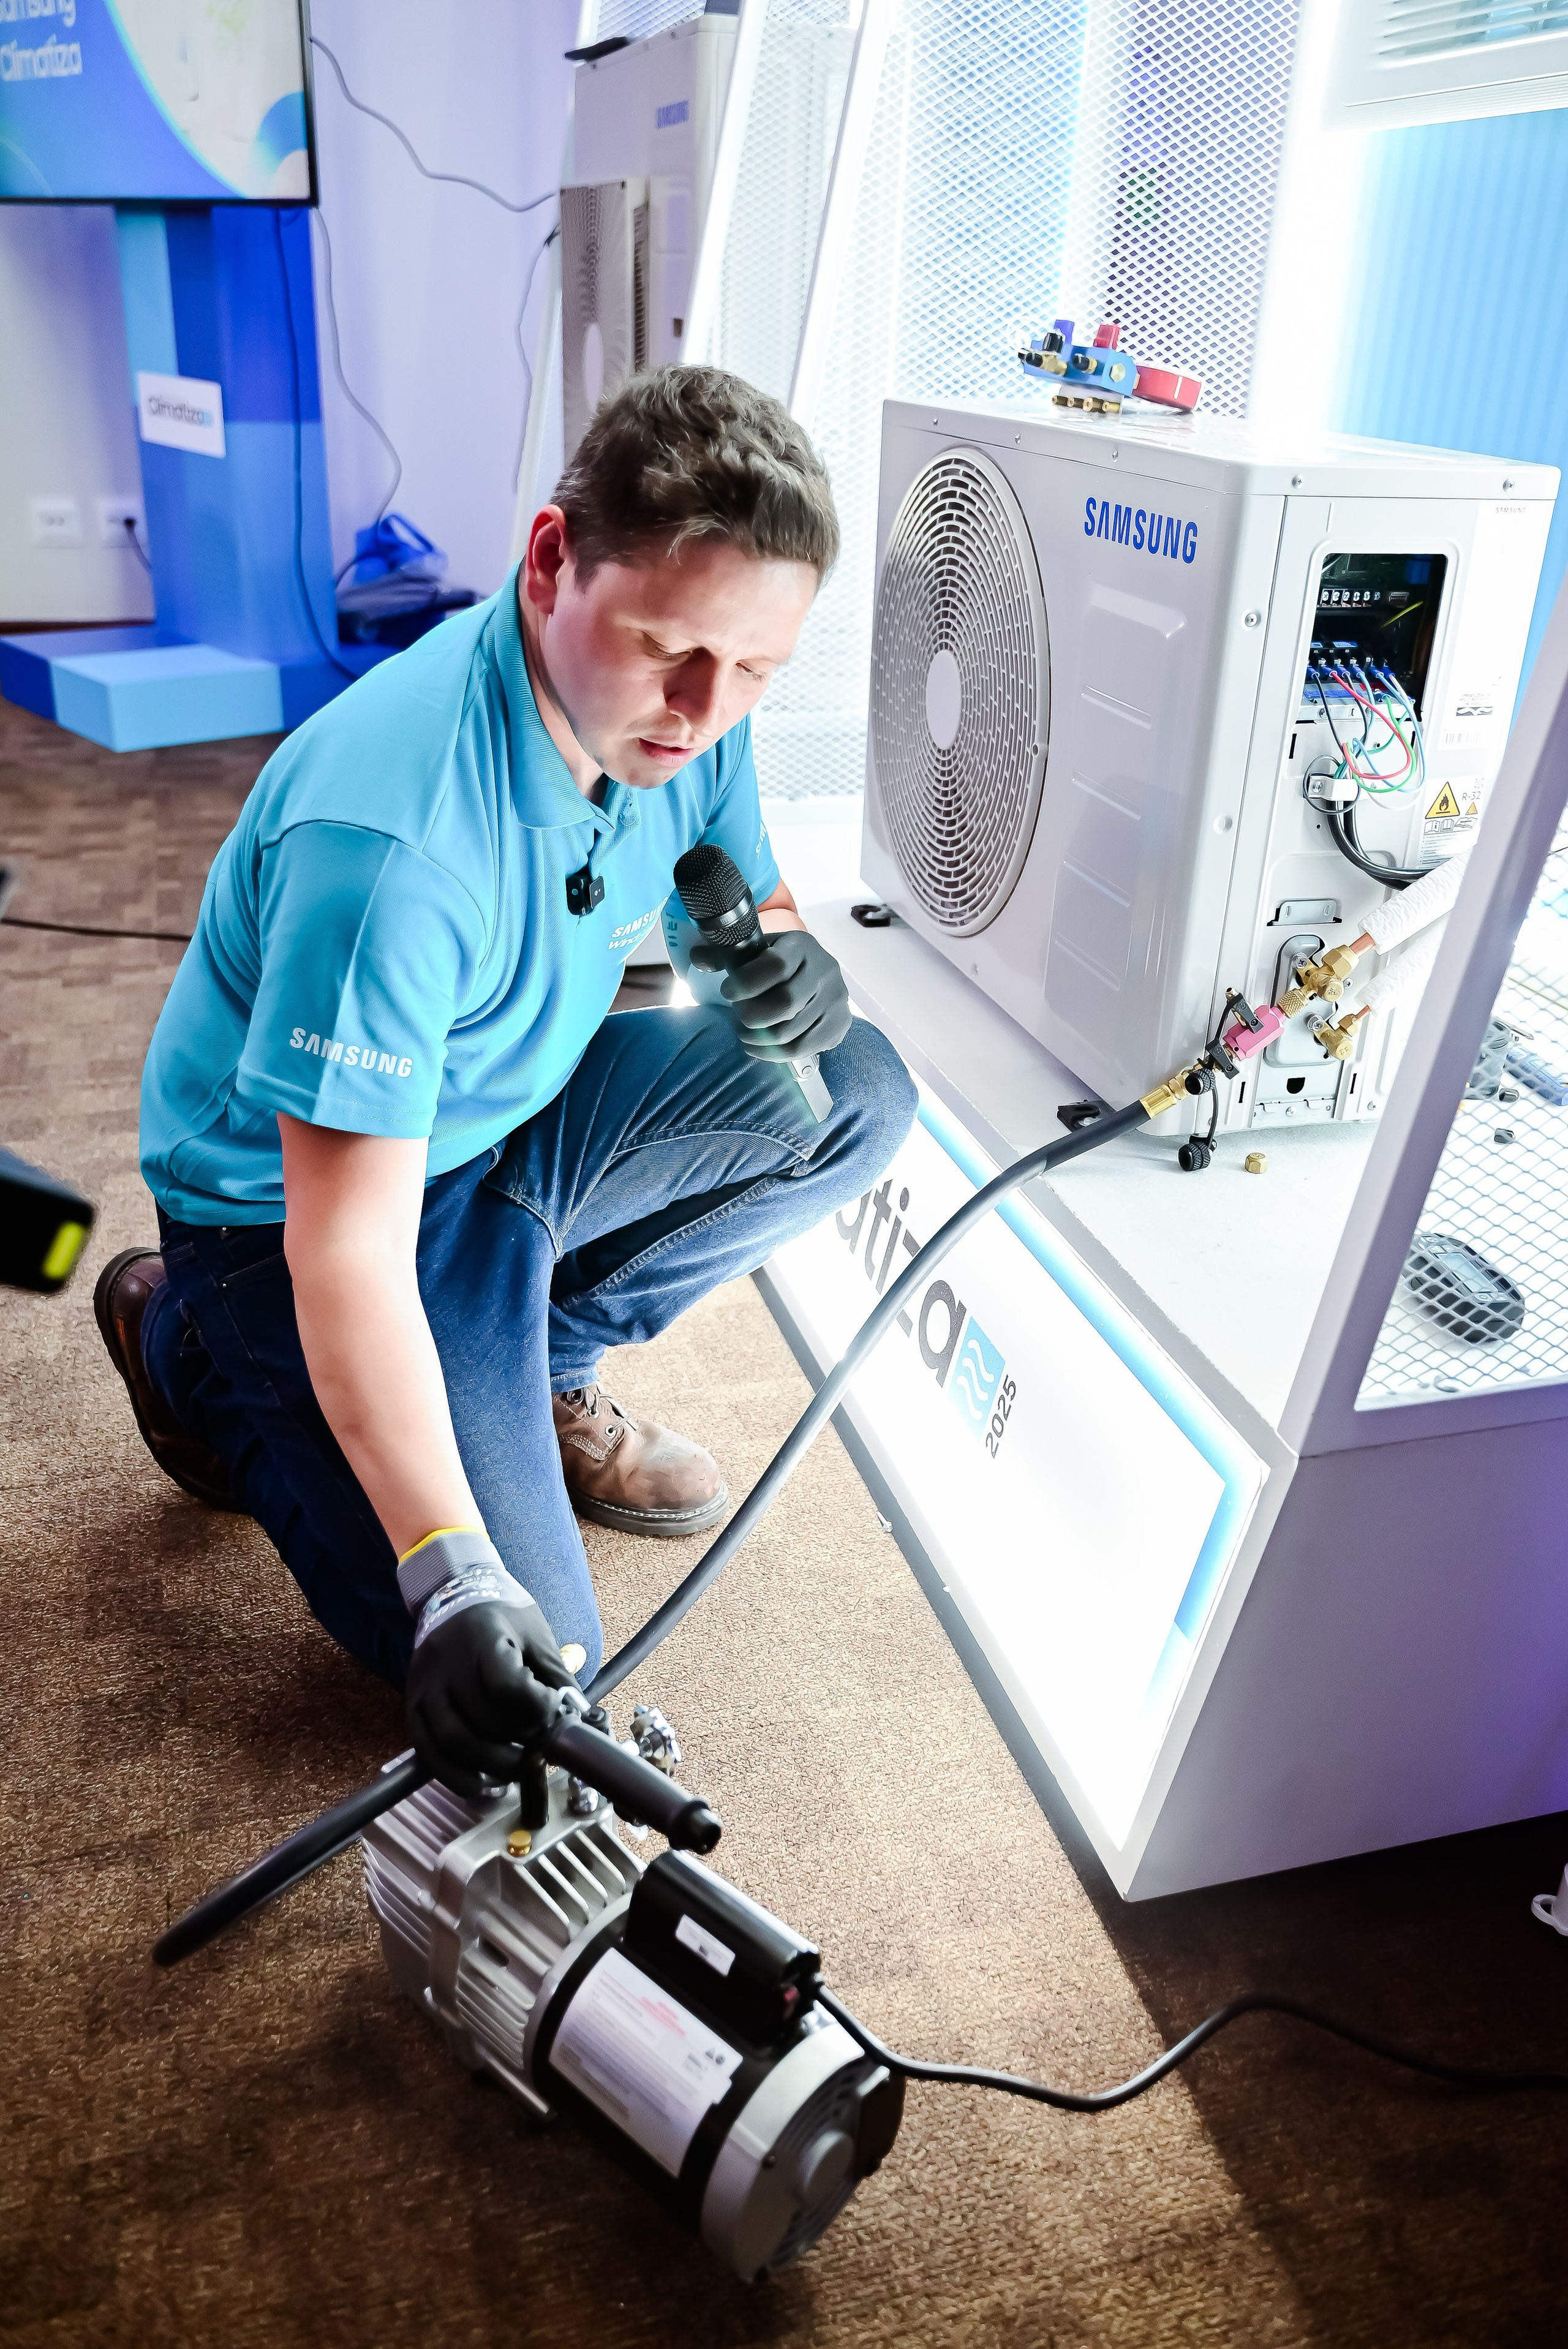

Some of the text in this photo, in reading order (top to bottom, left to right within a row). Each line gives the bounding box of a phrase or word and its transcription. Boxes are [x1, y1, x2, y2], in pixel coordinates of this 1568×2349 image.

[1084, 497, 1198, 564] SAMSUNG
[1462, 791, 1481, 801] R-32
[290, 1027, 413, 1078] SAMSUNG
[986, 1374, 1017, 1459] 2025
